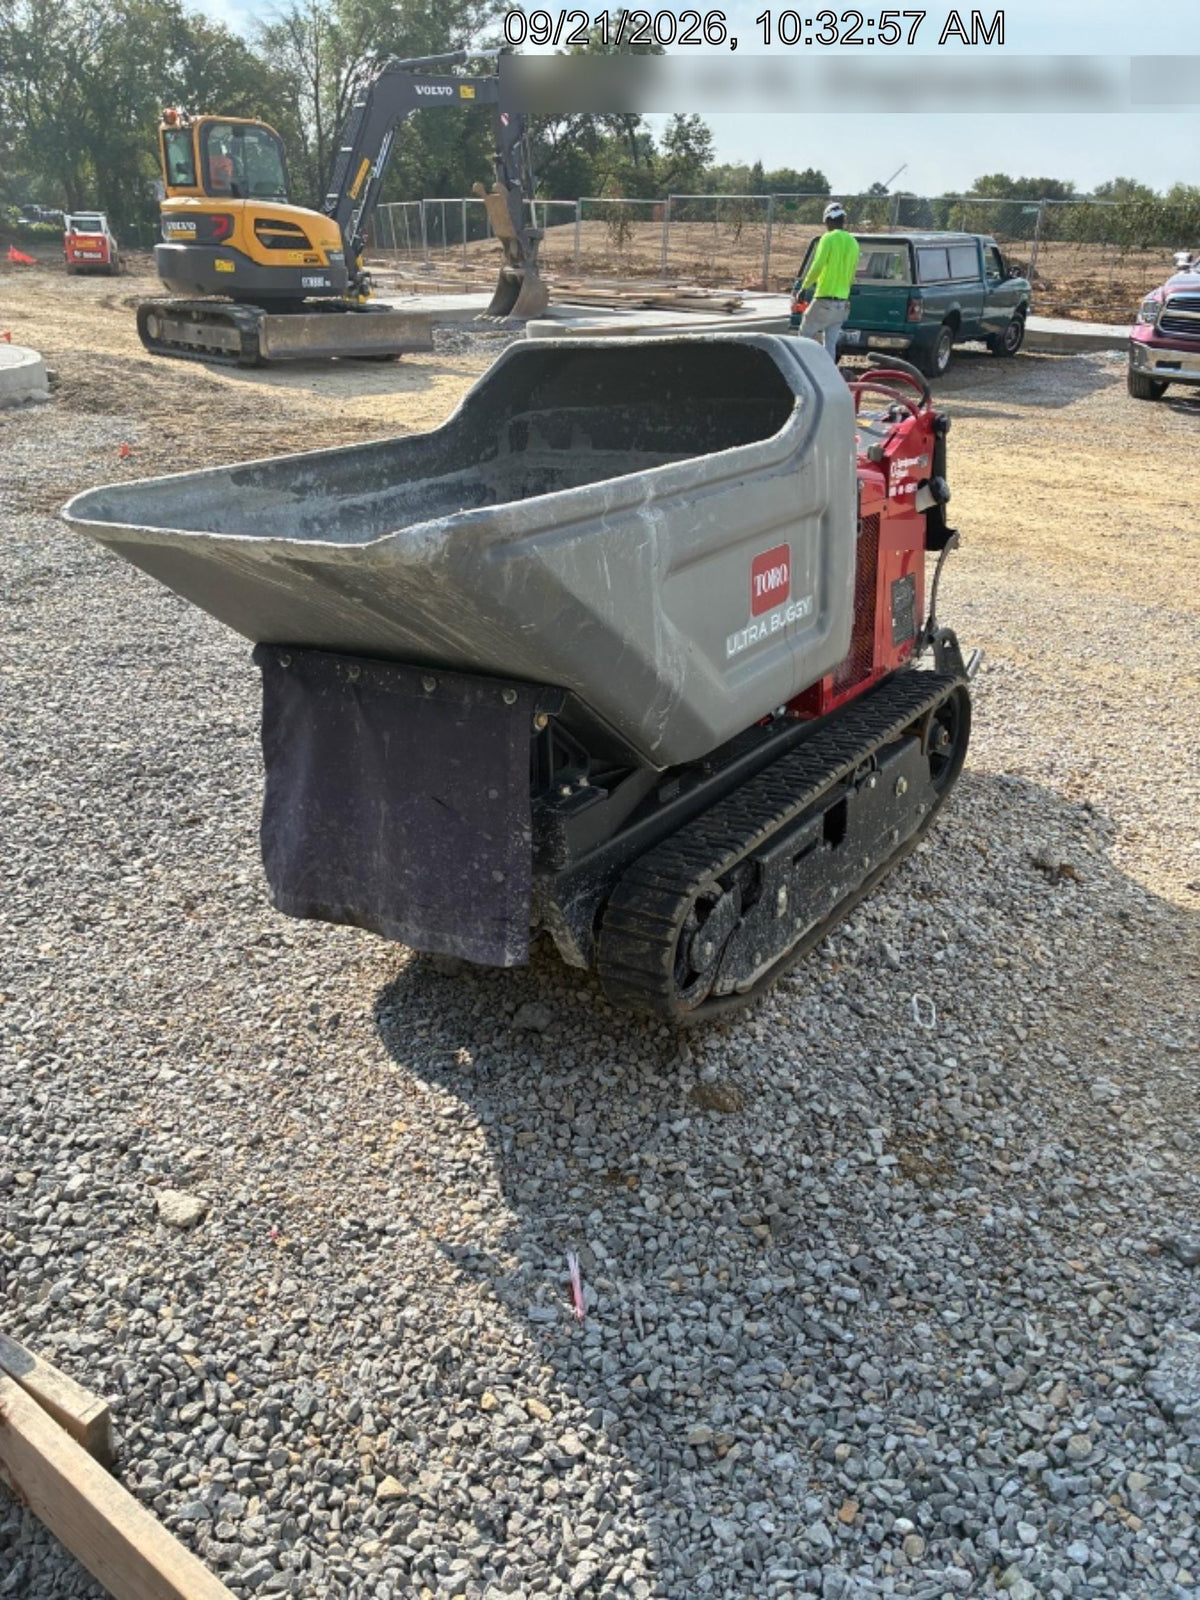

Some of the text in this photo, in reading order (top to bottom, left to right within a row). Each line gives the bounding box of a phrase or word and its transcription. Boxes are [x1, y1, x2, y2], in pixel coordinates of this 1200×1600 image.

[413, 84, 454, 96] VOLVO
[754, 563, 788, 597] TORO
[726, 595, 813, 656] ULTRA BUGGY
